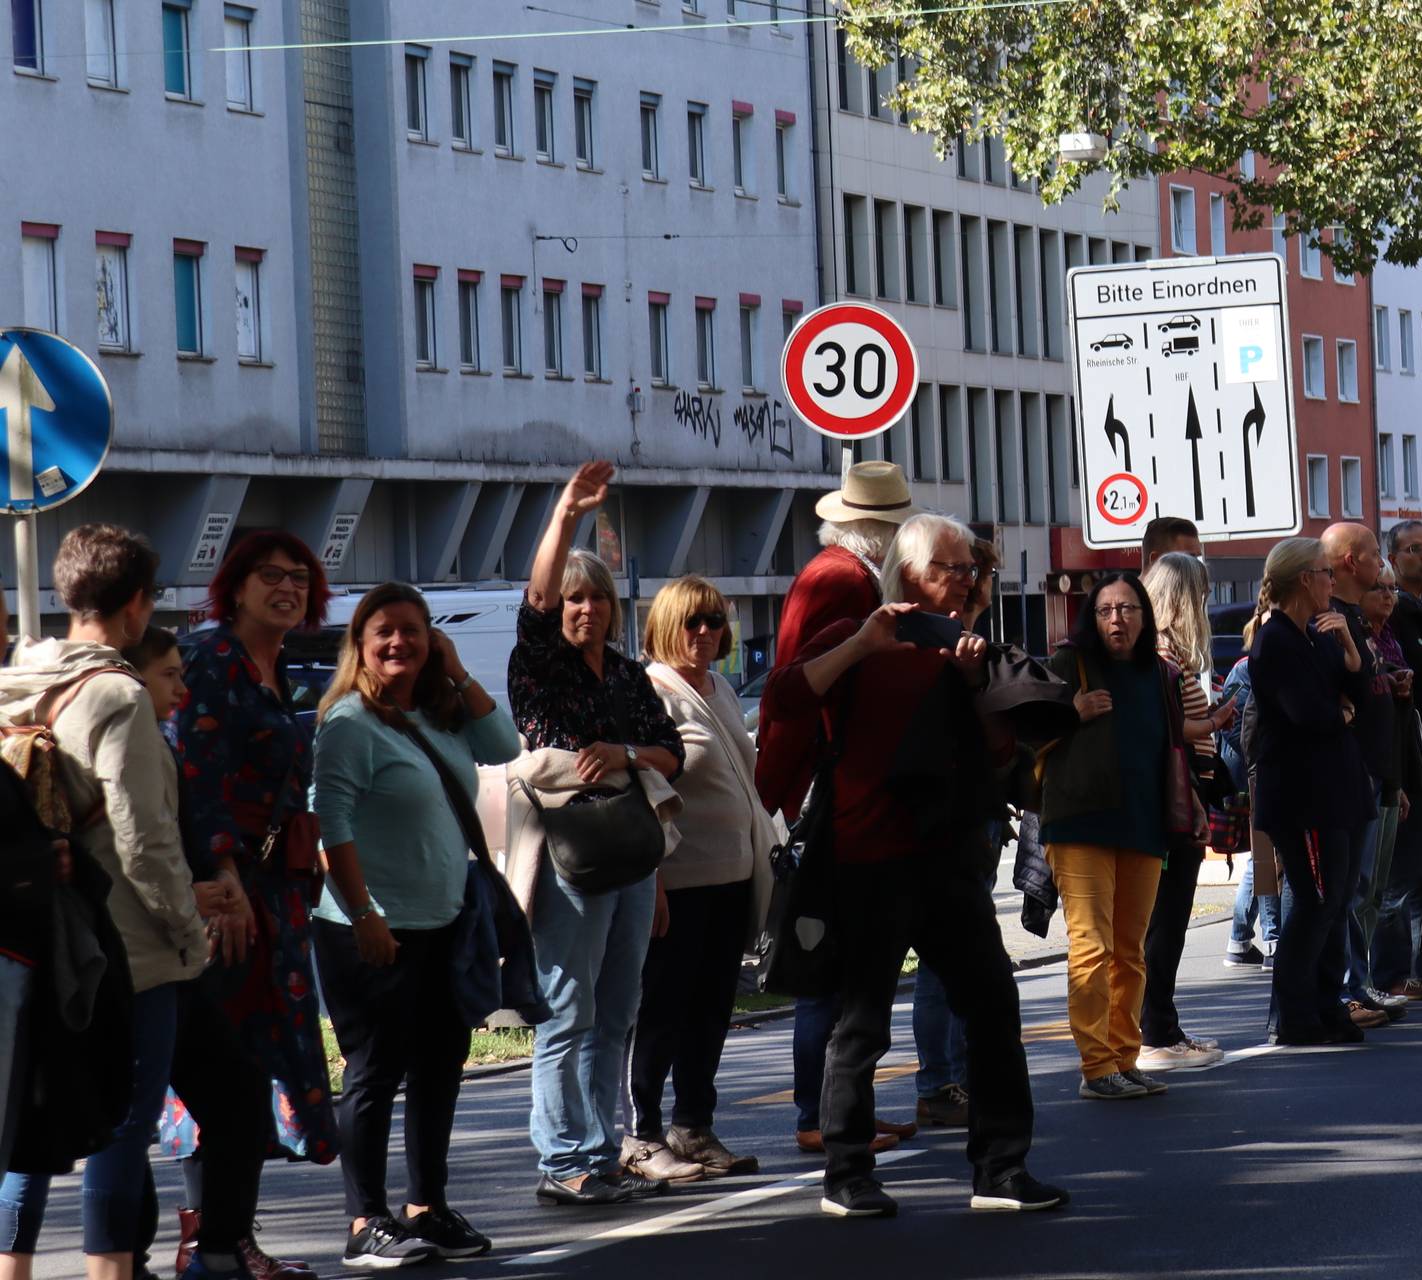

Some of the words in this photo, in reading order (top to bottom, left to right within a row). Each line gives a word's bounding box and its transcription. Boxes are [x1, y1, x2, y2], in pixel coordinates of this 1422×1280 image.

[1097, 284, 1143, 304] Bitte
[1152, 276, 1257, 300] Einordnen
[813, 341, 887, 400] 30
[1086, 357, 1125, 368] Rheinische
[1239, 346, 1263, 374] P
[755, 651, 762, 663] P
